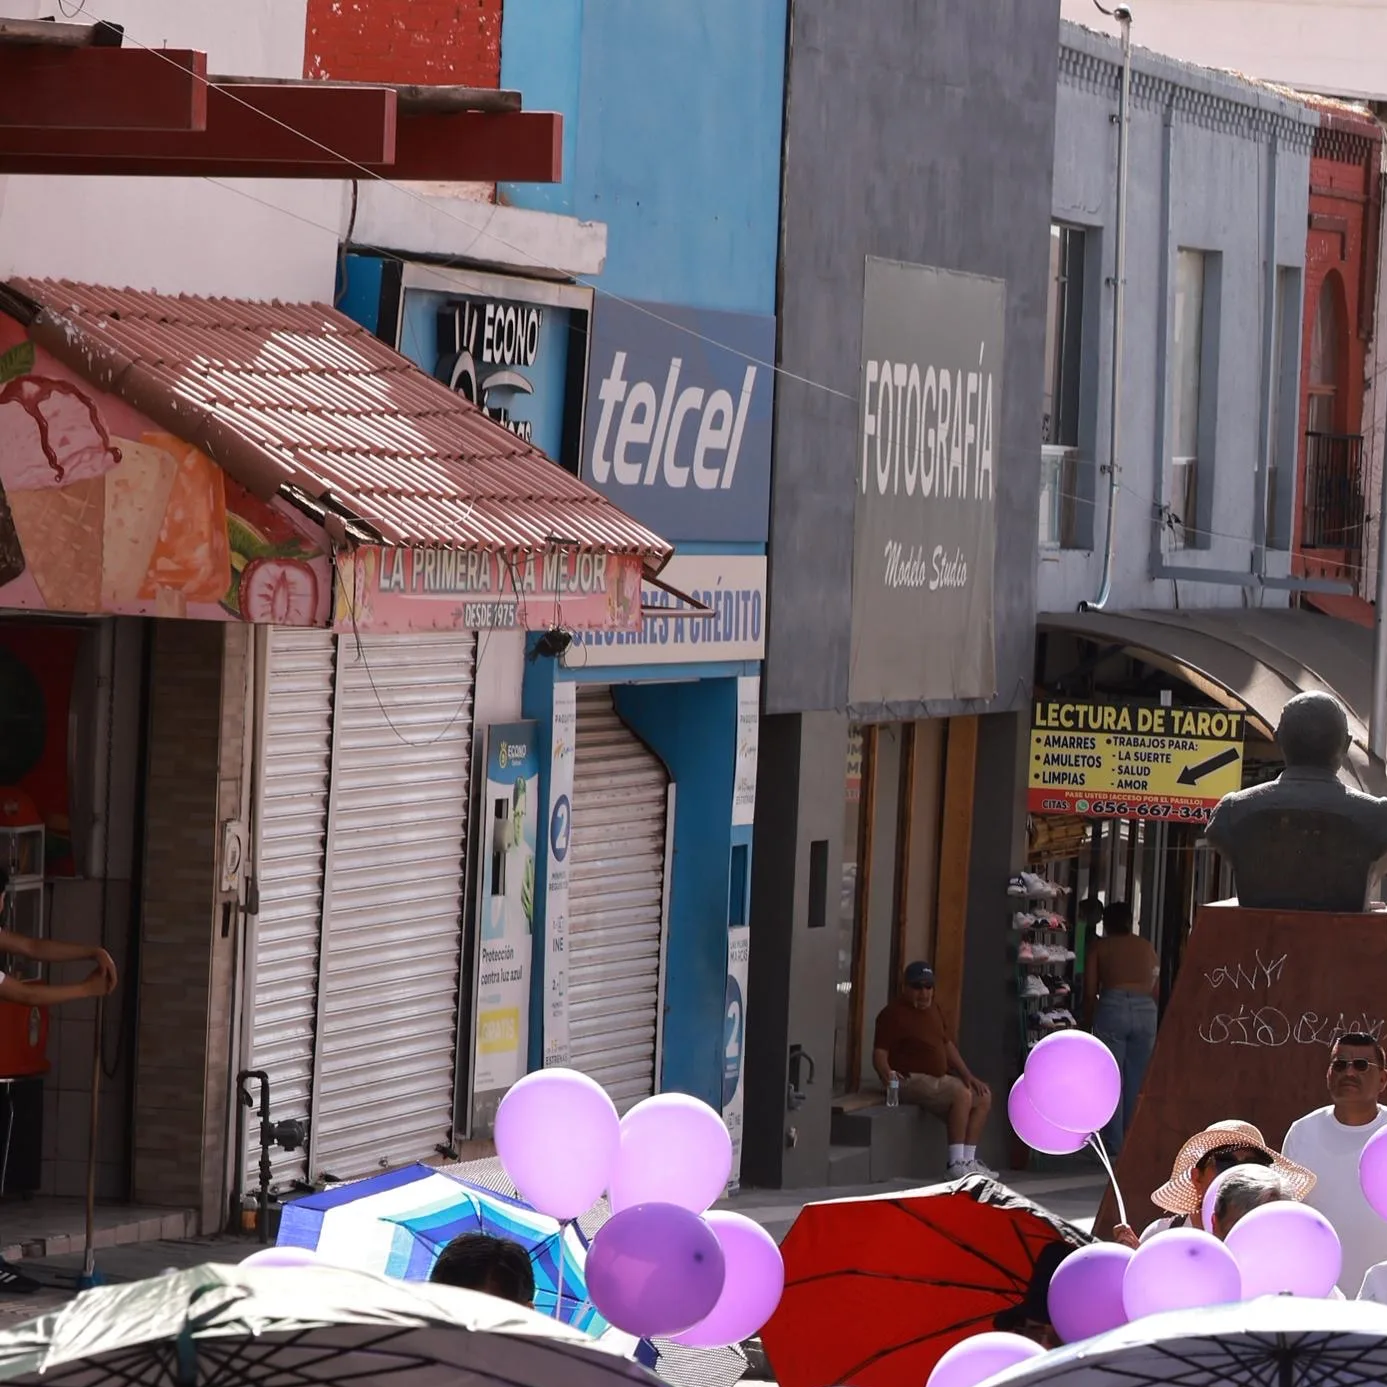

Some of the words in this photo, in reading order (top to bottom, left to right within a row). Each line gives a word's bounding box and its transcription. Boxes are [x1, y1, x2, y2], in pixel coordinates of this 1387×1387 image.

[591, 351, 757, 490] telcel
[862, 341, 993, 501] FOTOGRAFÍA
[378, 548, 405, 593] LA
[411, 549, 492, 594] PRIMERA
[542, 551, 608, 595] MEJOR
[884, 539, 926, 589] Modelo
[929, 544, 968, 591] Studio
[464, 602, 492, 627] DESDE
[492, 602, 517, 627] 1975
[689, 576, 762, 644] CRÉDITO
[1035, 702, 1132, 731] LECTURA
[1137, 707, 1165, 734] DE
[1171, 709, 1241, 738] TAROT
[1043, 735, 1096, 750] AMARRES
[1113, 736, 1166, 749] TRABAJOS
[1168, 737, 1199, 751] PARA:
[1043, 754, 1102, 769] AMULETOS
[1118, 751, 1131, 761] LA
[1134, 752, 1172, 764] SUERTE
[1042, 771, 1086, 786] LIMPIAS
[1117, 765, 1151, 777] SALUD
[1116, 779, 1148, 791] AMOR
[1065, 791, 1084, 799] PASE
[1084, 792, 1108, 800] USTED
[1143, 795, 1160, 803] POR
[1092, 801, 1212, 820] 656-667-341
[555, 803, 568, 849] 2
[482, 944, 514, 963] Protección
[552, 937, 564, 952] INE
[481, 971, 500, 986] contra
[500, 968, 510, 983] luz
[510, 965, 522, 981] azul
[727, 1000, 740, 1058] 2
